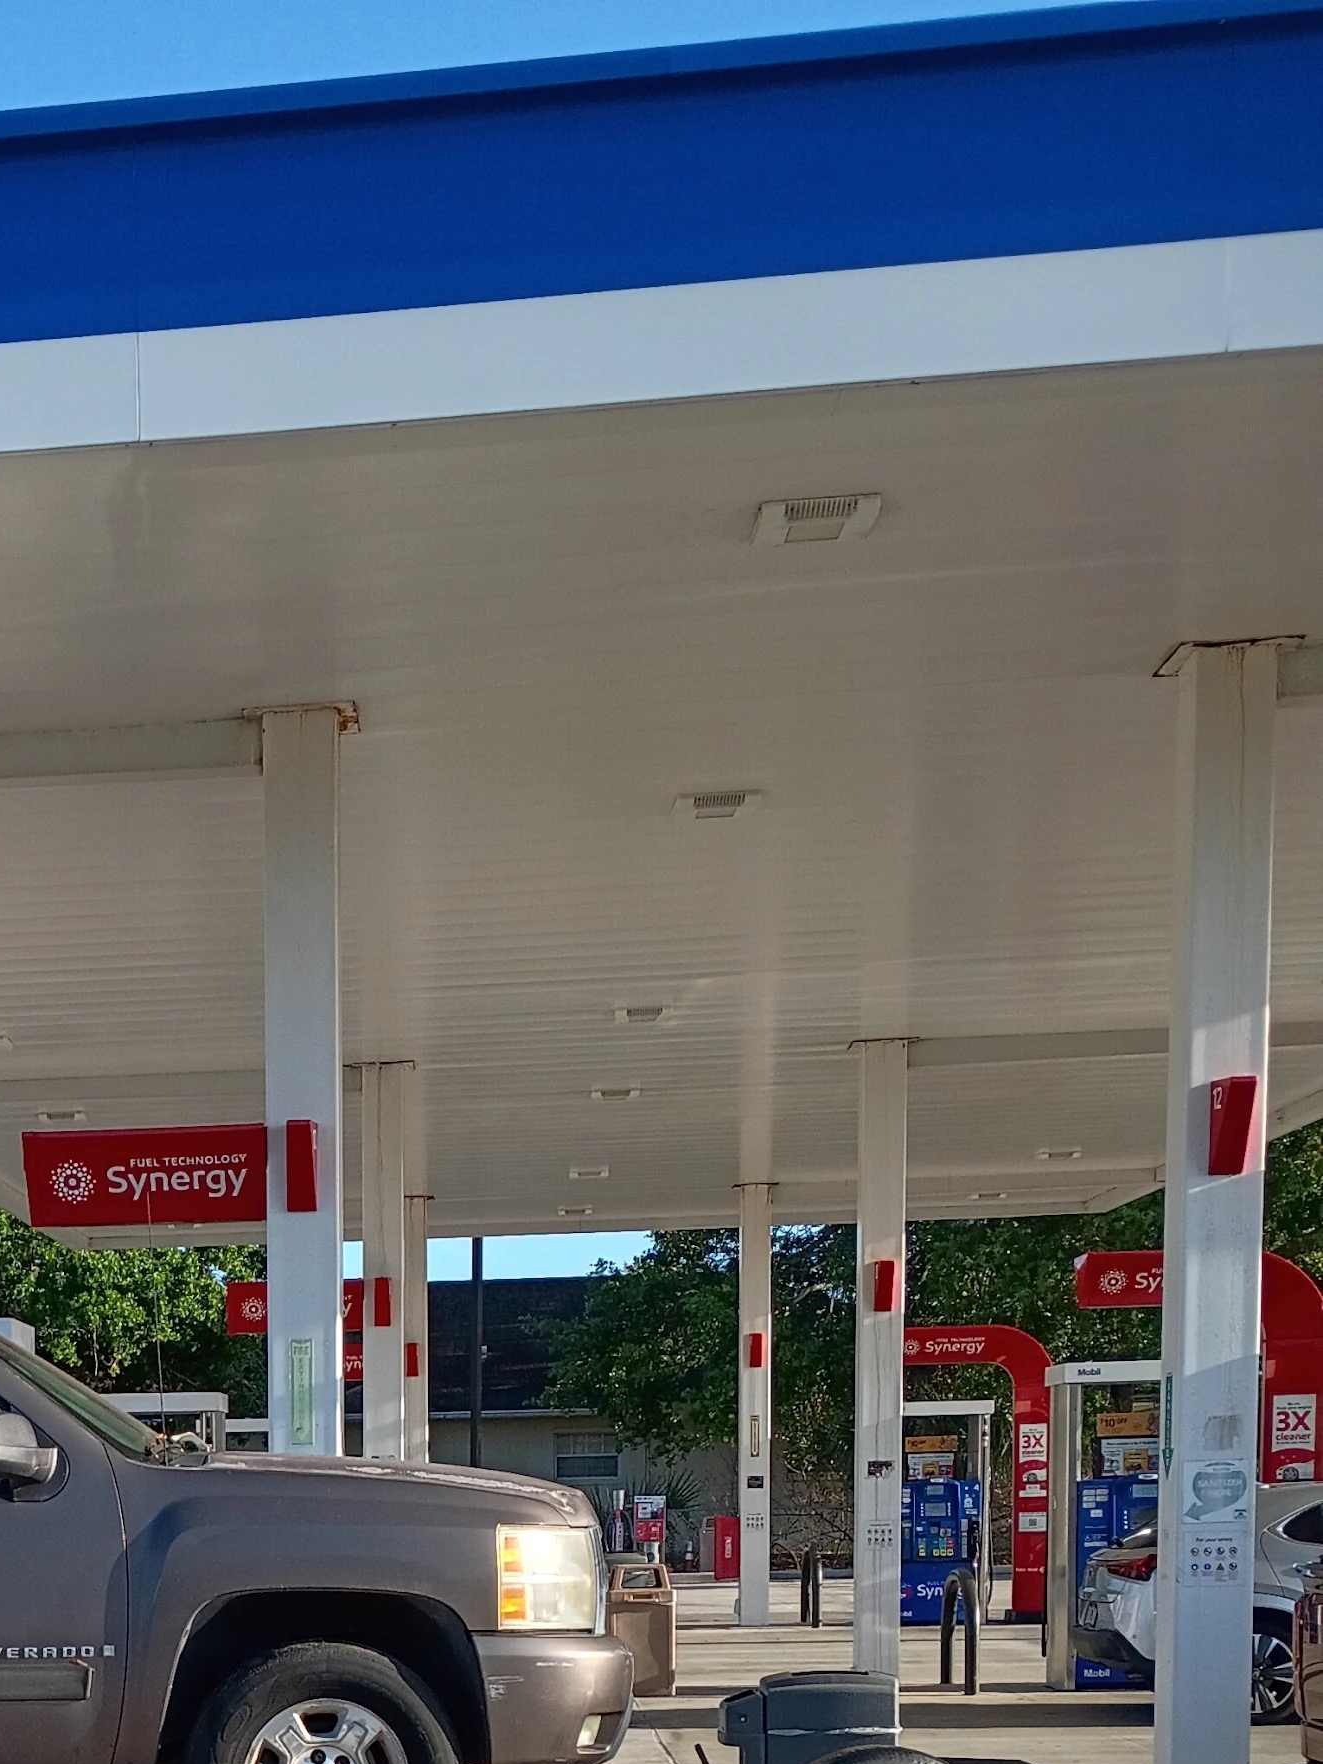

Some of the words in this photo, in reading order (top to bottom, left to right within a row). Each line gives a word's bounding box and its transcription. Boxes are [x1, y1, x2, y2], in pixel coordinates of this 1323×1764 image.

[130, 1158, 161, 1168] FUEL
[162, 1153, 248, 1167] TECHNOLOGY
[106, 1164, 249, 1201] Synergy
[925, 1341, 985, 1354] Synergy
[1077, 1368, 1102, 1377] Mobil
[1276, 1410, 1311, 1432] 3X
[1022, 1434, 1044, 1449] 3X
[1276, 1433, 1311, 1441] cleaner
[1083, 1668, 1110, 1677] Mobil
